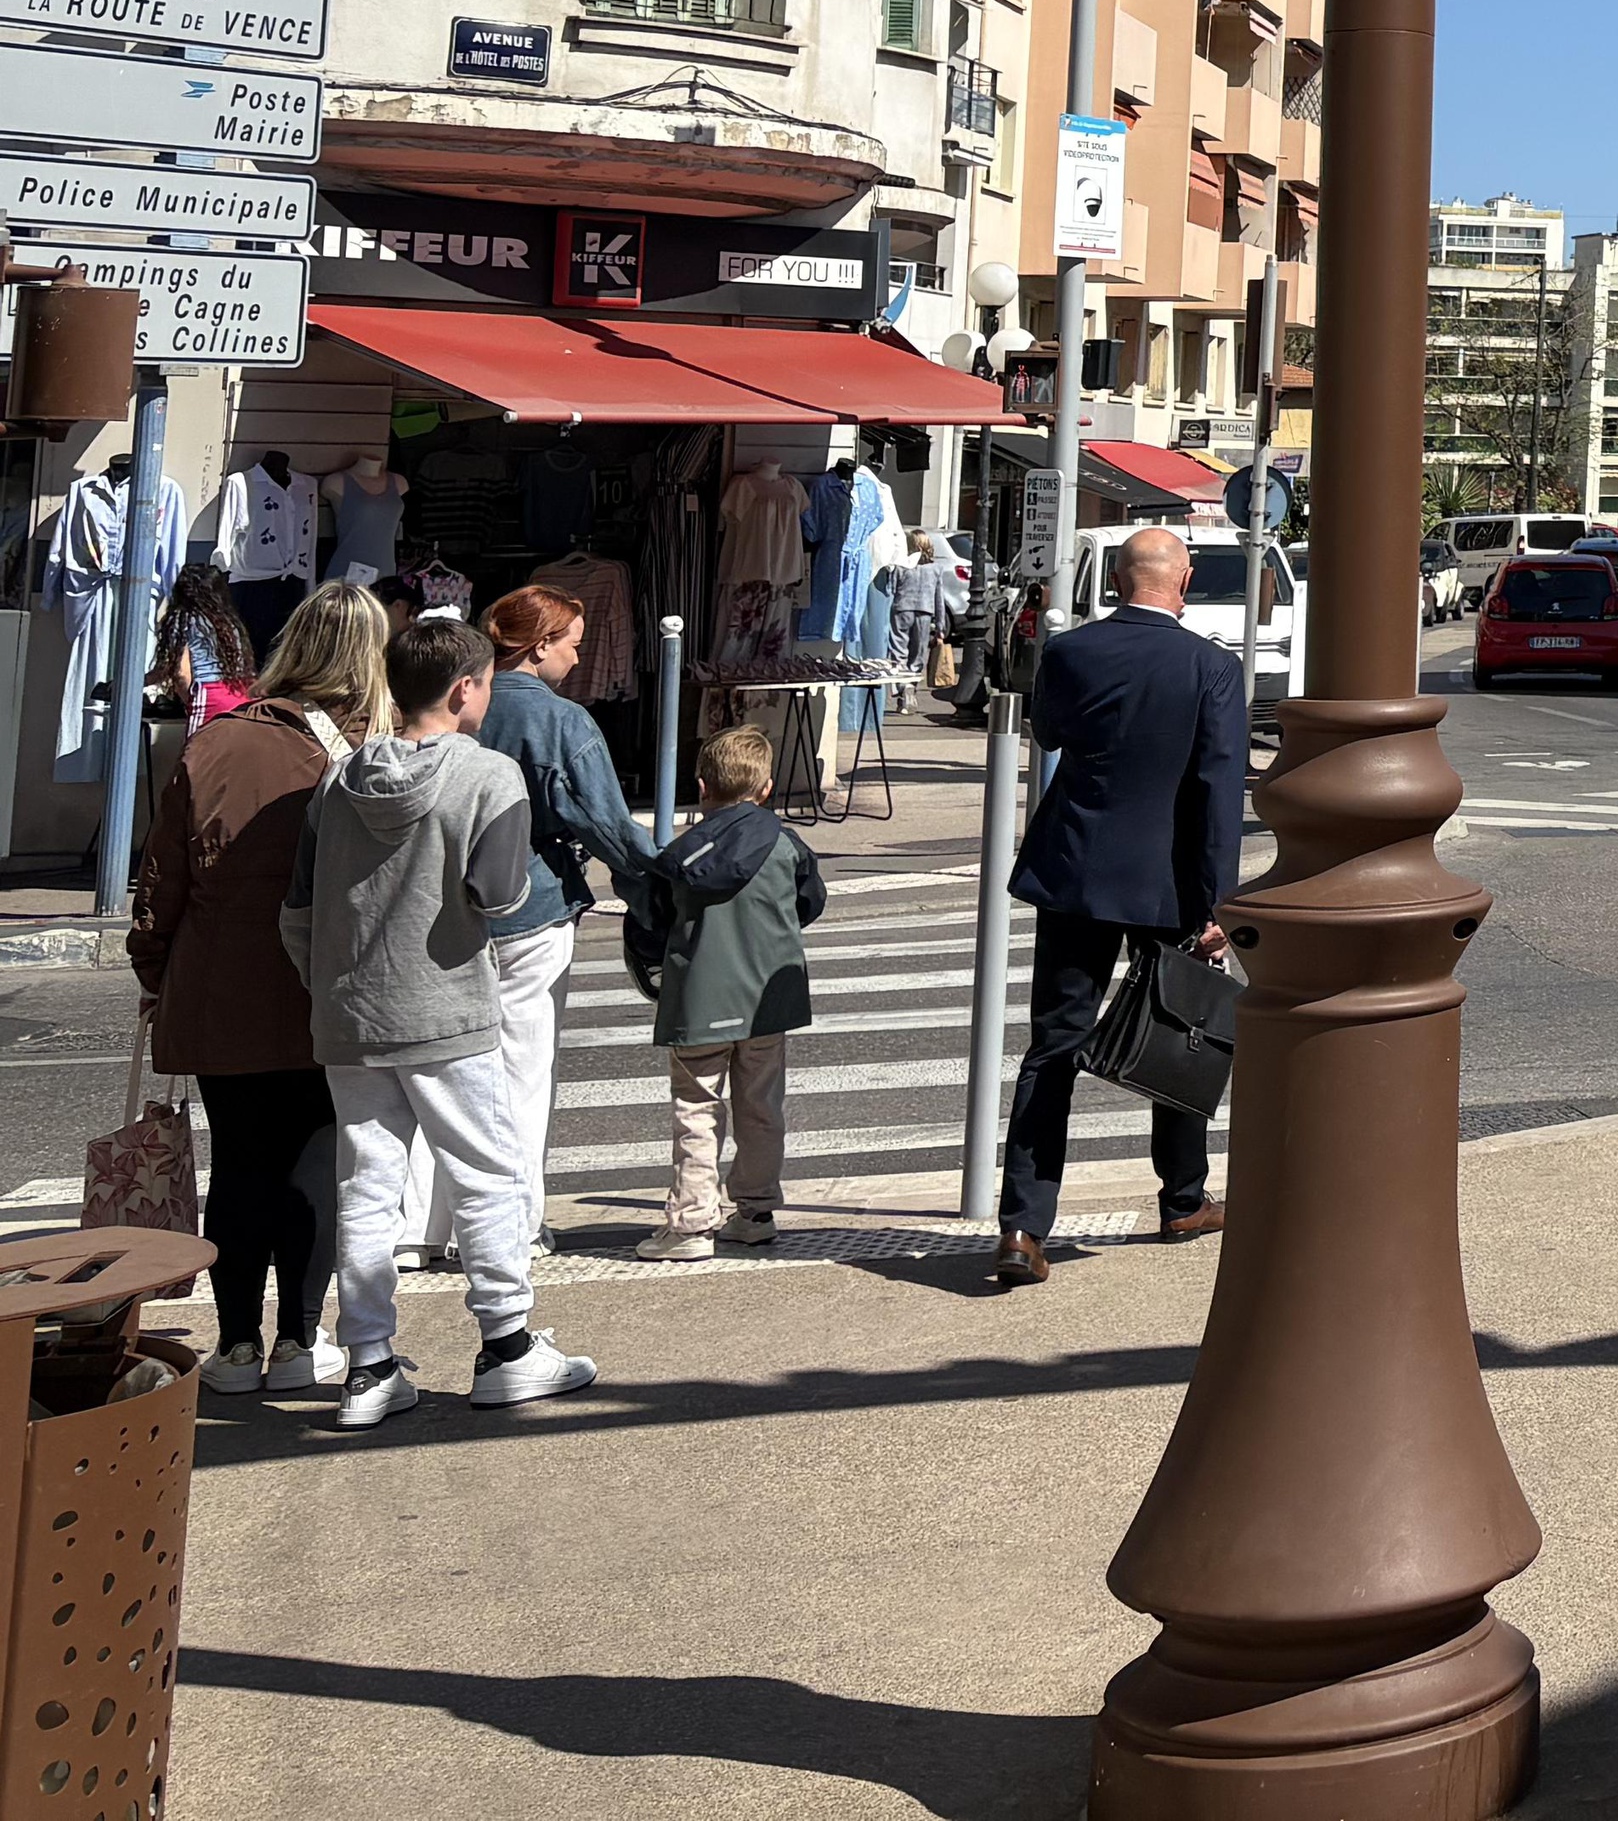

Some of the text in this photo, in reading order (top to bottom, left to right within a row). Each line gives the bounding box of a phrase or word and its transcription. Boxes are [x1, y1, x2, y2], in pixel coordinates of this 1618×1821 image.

[181, 14, 204, 30] DE
[224, 10, 312, 45] VENCE
[472, 31, 534, 49] AVENUE
[512, 54, 545, 72] POSTES
[230, 84, 306, 114] Poste
[214, 115, 304, 146] Mairie
[18, 177, 297, 224] Police Municipale
[571, 252, 636, 265] KIFFEUR
[728, 257, 773, 279] FOR
[783, 260, 829, 282] YOU
[221, 264, 252, 290] du
[174, 293, 261, 326] Cagne
[172, 326, 289, 354] Collines
[1027, 476, 1058, 491] PIÉTONS
